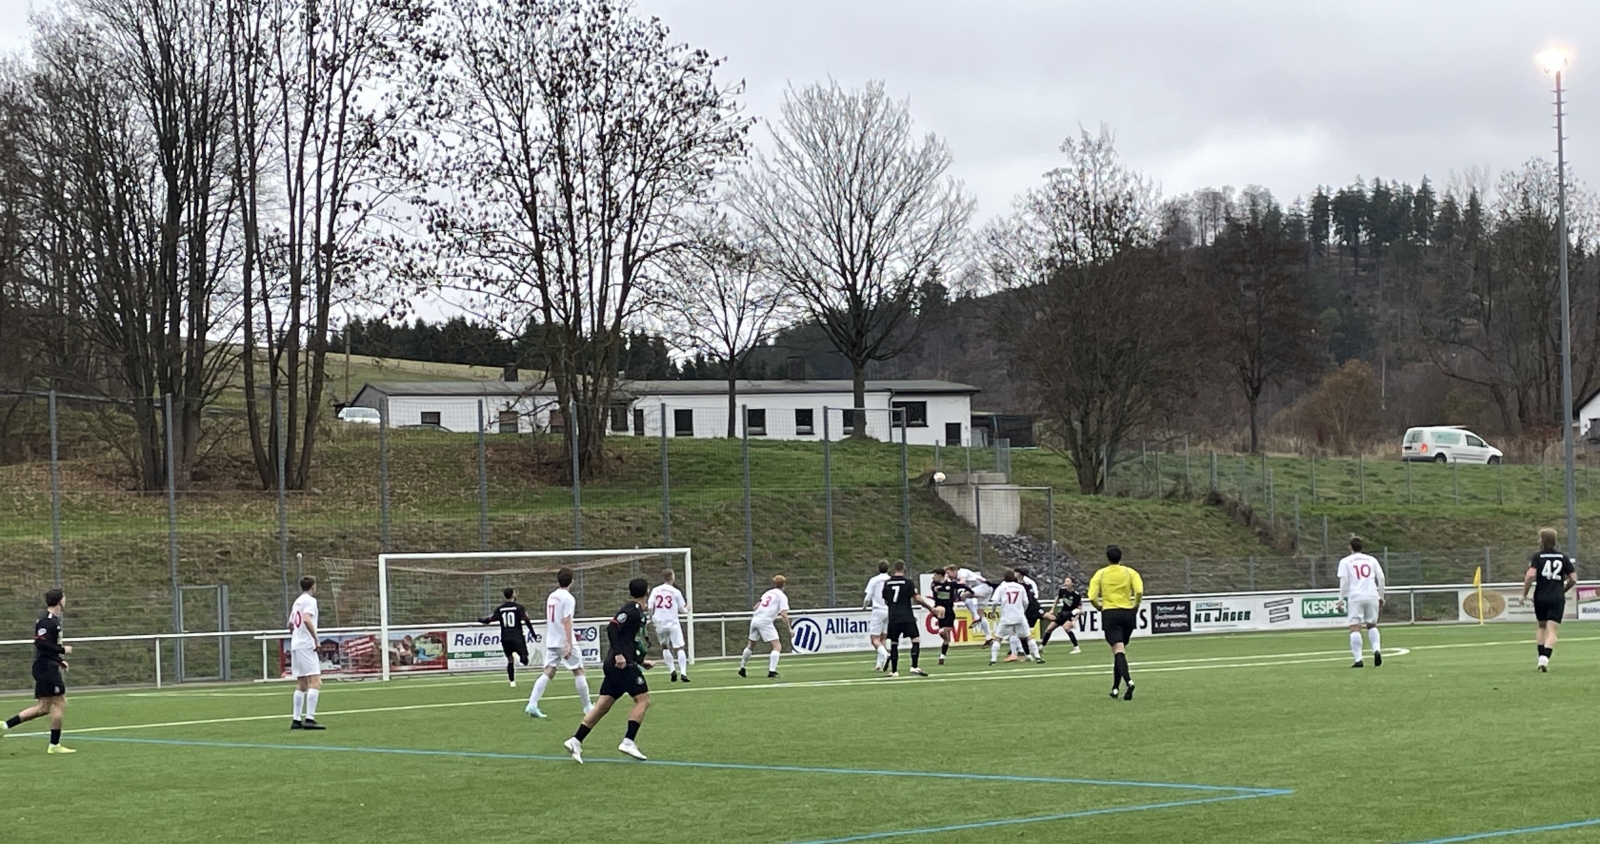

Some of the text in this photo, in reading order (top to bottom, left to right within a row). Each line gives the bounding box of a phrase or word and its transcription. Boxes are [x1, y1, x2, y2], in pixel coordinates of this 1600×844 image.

[1353, 564, 1371, 580] 10
[1541, 560, 1563, 580] 42
[891, 585, 900, 602] 7
[1006, 591, 1020, 604] 17
[655, 594, 673, 609] 23
[761, 596, 772, 608] 3
[501, 611, 516, 628] 10
[454, 632, 500, 647] Reifen
